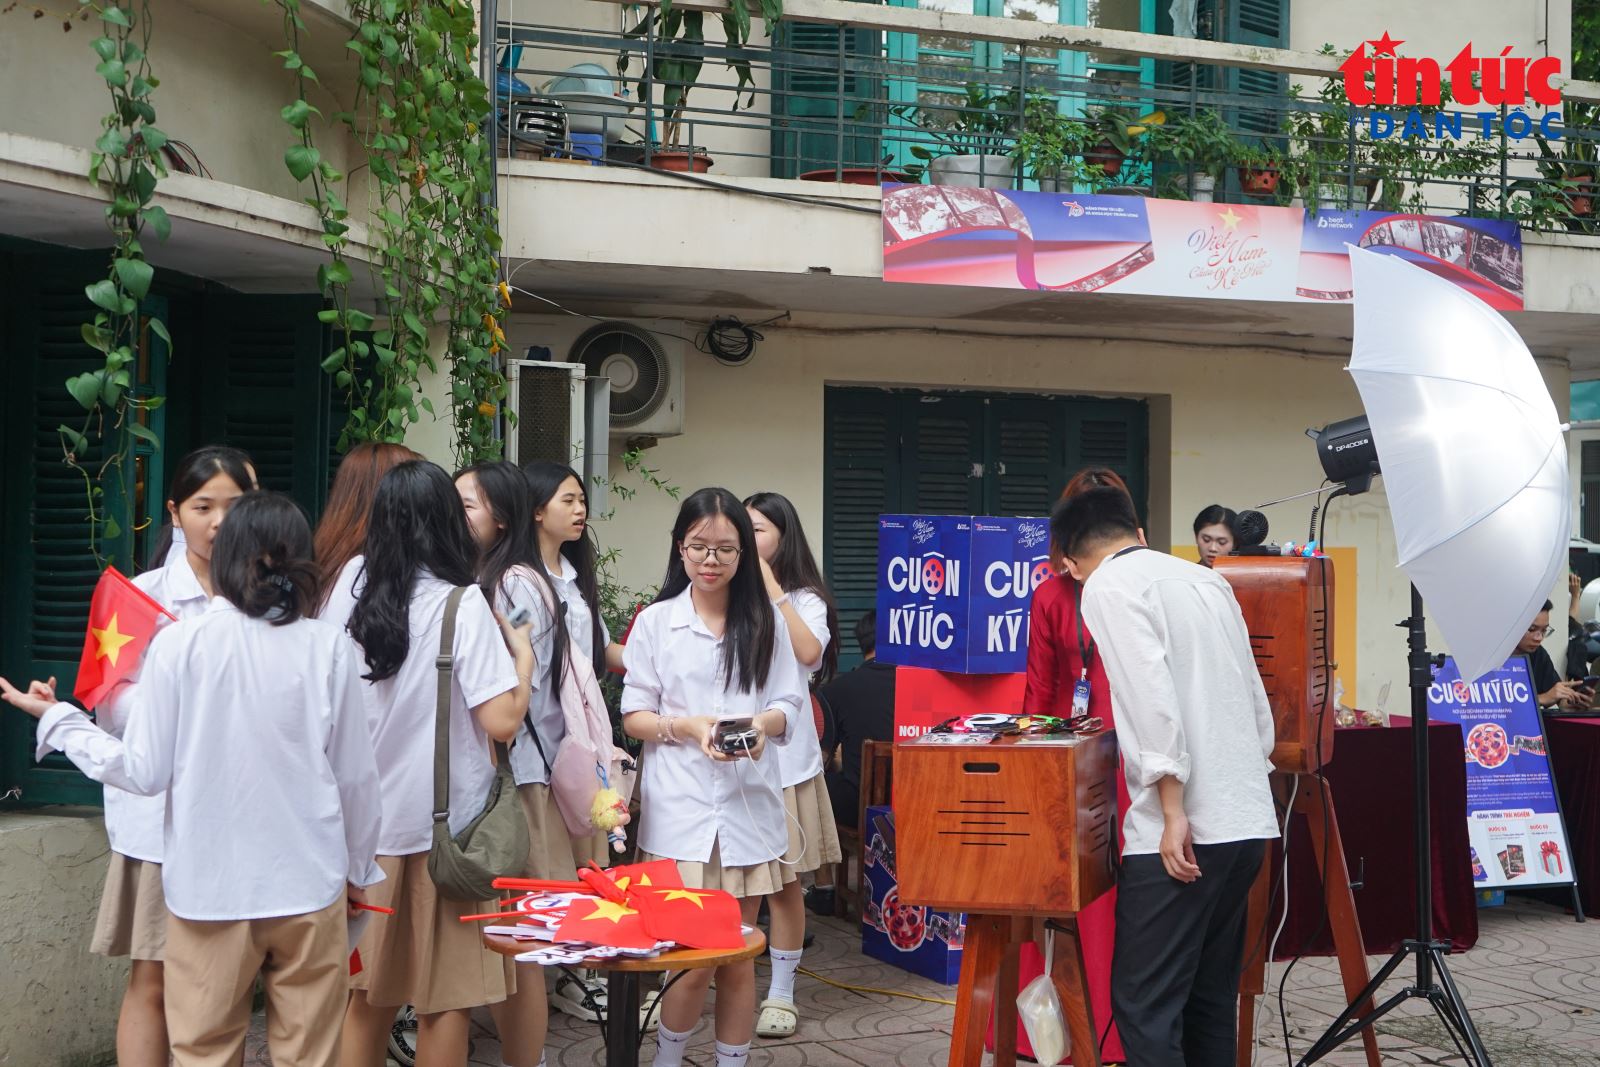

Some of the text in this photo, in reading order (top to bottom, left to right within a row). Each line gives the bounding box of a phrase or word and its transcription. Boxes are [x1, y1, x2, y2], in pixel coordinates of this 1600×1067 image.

[1207, 235, 1267, 266] Nam
[888, 551, 960, 600] CUỘN
[889, 603, 954, 650] KÝ ỨC
[987, 608, 1023, 652] KÝ
[1428, 679, 1529, 706] CUỘN KÝ ỨC
[899, 725, 920, 737] NƠI
